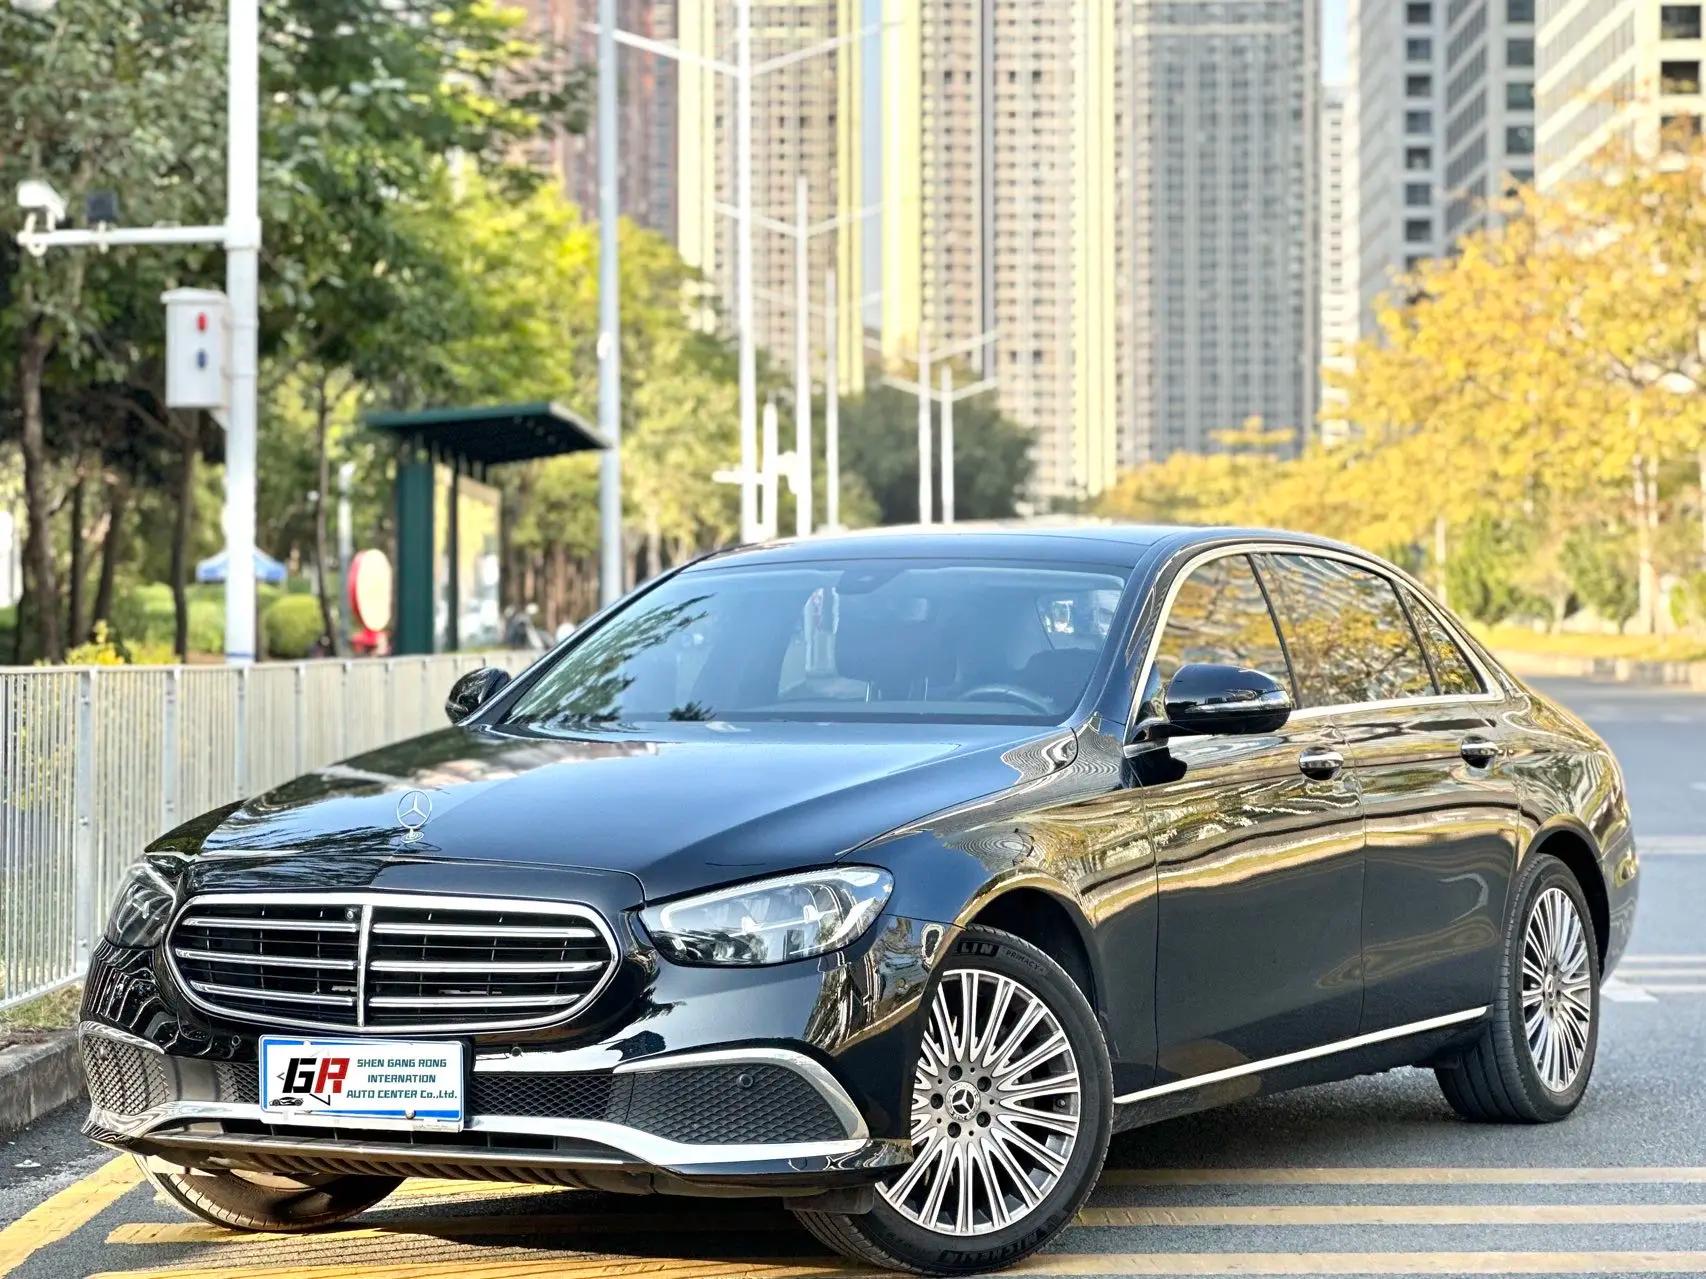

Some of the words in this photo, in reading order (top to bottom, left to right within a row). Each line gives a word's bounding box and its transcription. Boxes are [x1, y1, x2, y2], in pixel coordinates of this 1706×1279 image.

[1005, 949, 1041, 970] PRIMACY
[357, 1059, 384, 1068] SHEN
[387, 1059, 416, 1068] GANG
[418, 1059, 447, 1068] RONG
[282, 1058, 350, 1093] GR
[367, 1074, 436, 1083] INTERNATION
[346, 1090, 375, 1098] AUTO
[377, 1090, 417, 1098] CENTER
[420, 1090, 457, 1099] Co.,Ltd.
